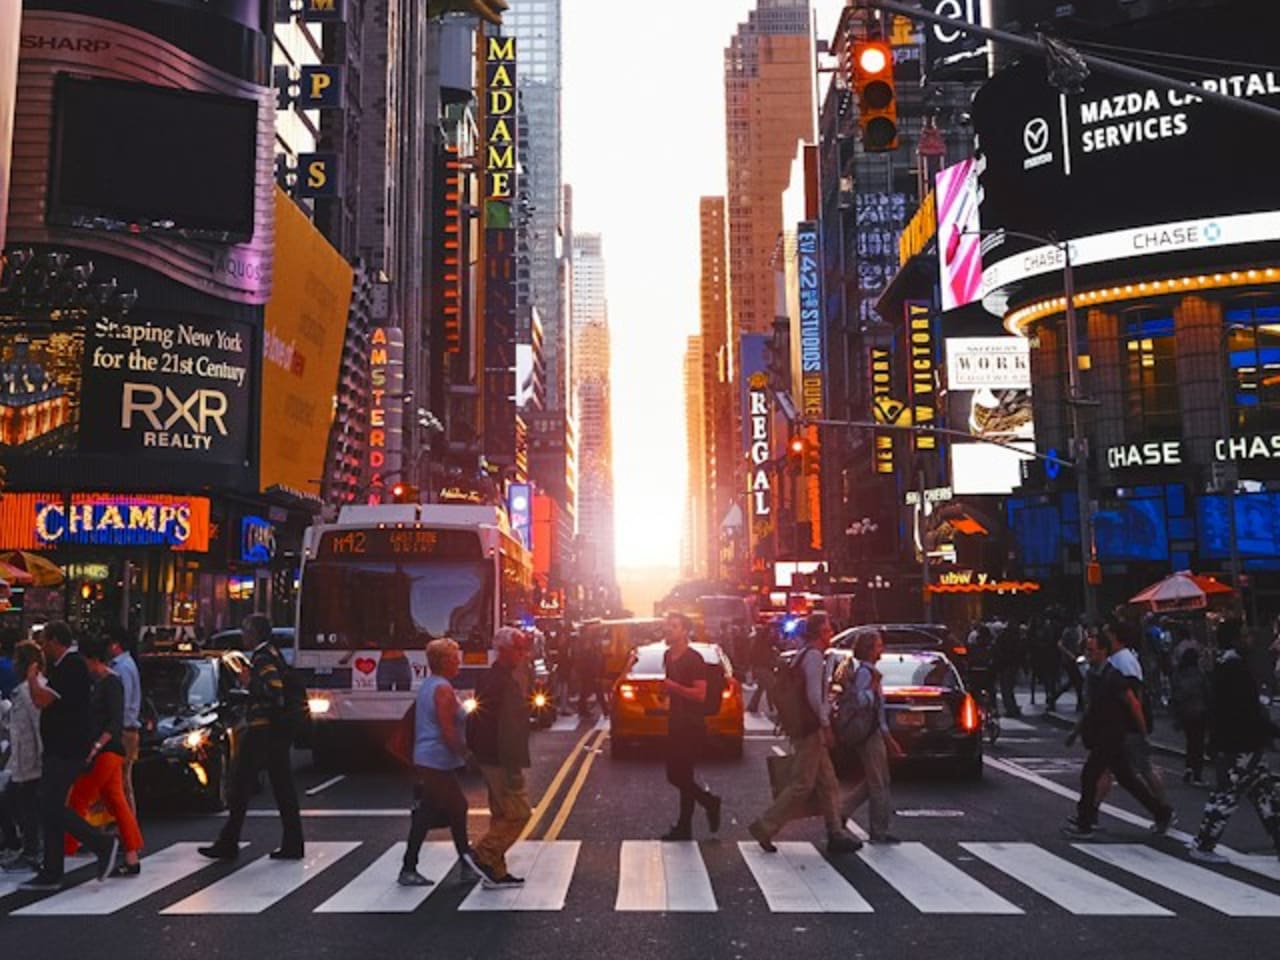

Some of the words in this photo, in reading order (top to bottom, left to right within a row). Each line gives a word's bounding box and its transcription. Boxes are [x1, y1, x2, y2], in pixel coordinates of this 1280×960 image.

[20, 34, 111, 54] SHARP
[487, 36, 517, 198] MADAME
[1080, 89, 1161, 125] MAZDA
[1081, 113, 1189, 153] SERVICES
[1132, 225, 1200, 250] CHASE
[177, 324, 214, 347] New
[216, 329, 244, 354] York
[801, 309, 821, 373] STUDIOS
[910, 304, 934, 396] VICTORY
[93, 346, 125, 369] for
[128, 349, 158, 372] the
[161, 354, 194, 375] 21st
[196, 357, 247, 388] Century
[121, 382, 228, 437] RXR
[144, 432, 213, 451] REALTY
[749, 390, 771, 516] REGAL
[1107, 441, 1181, 469] CHASE
[36, 502, 191, 545] CHAMPS
